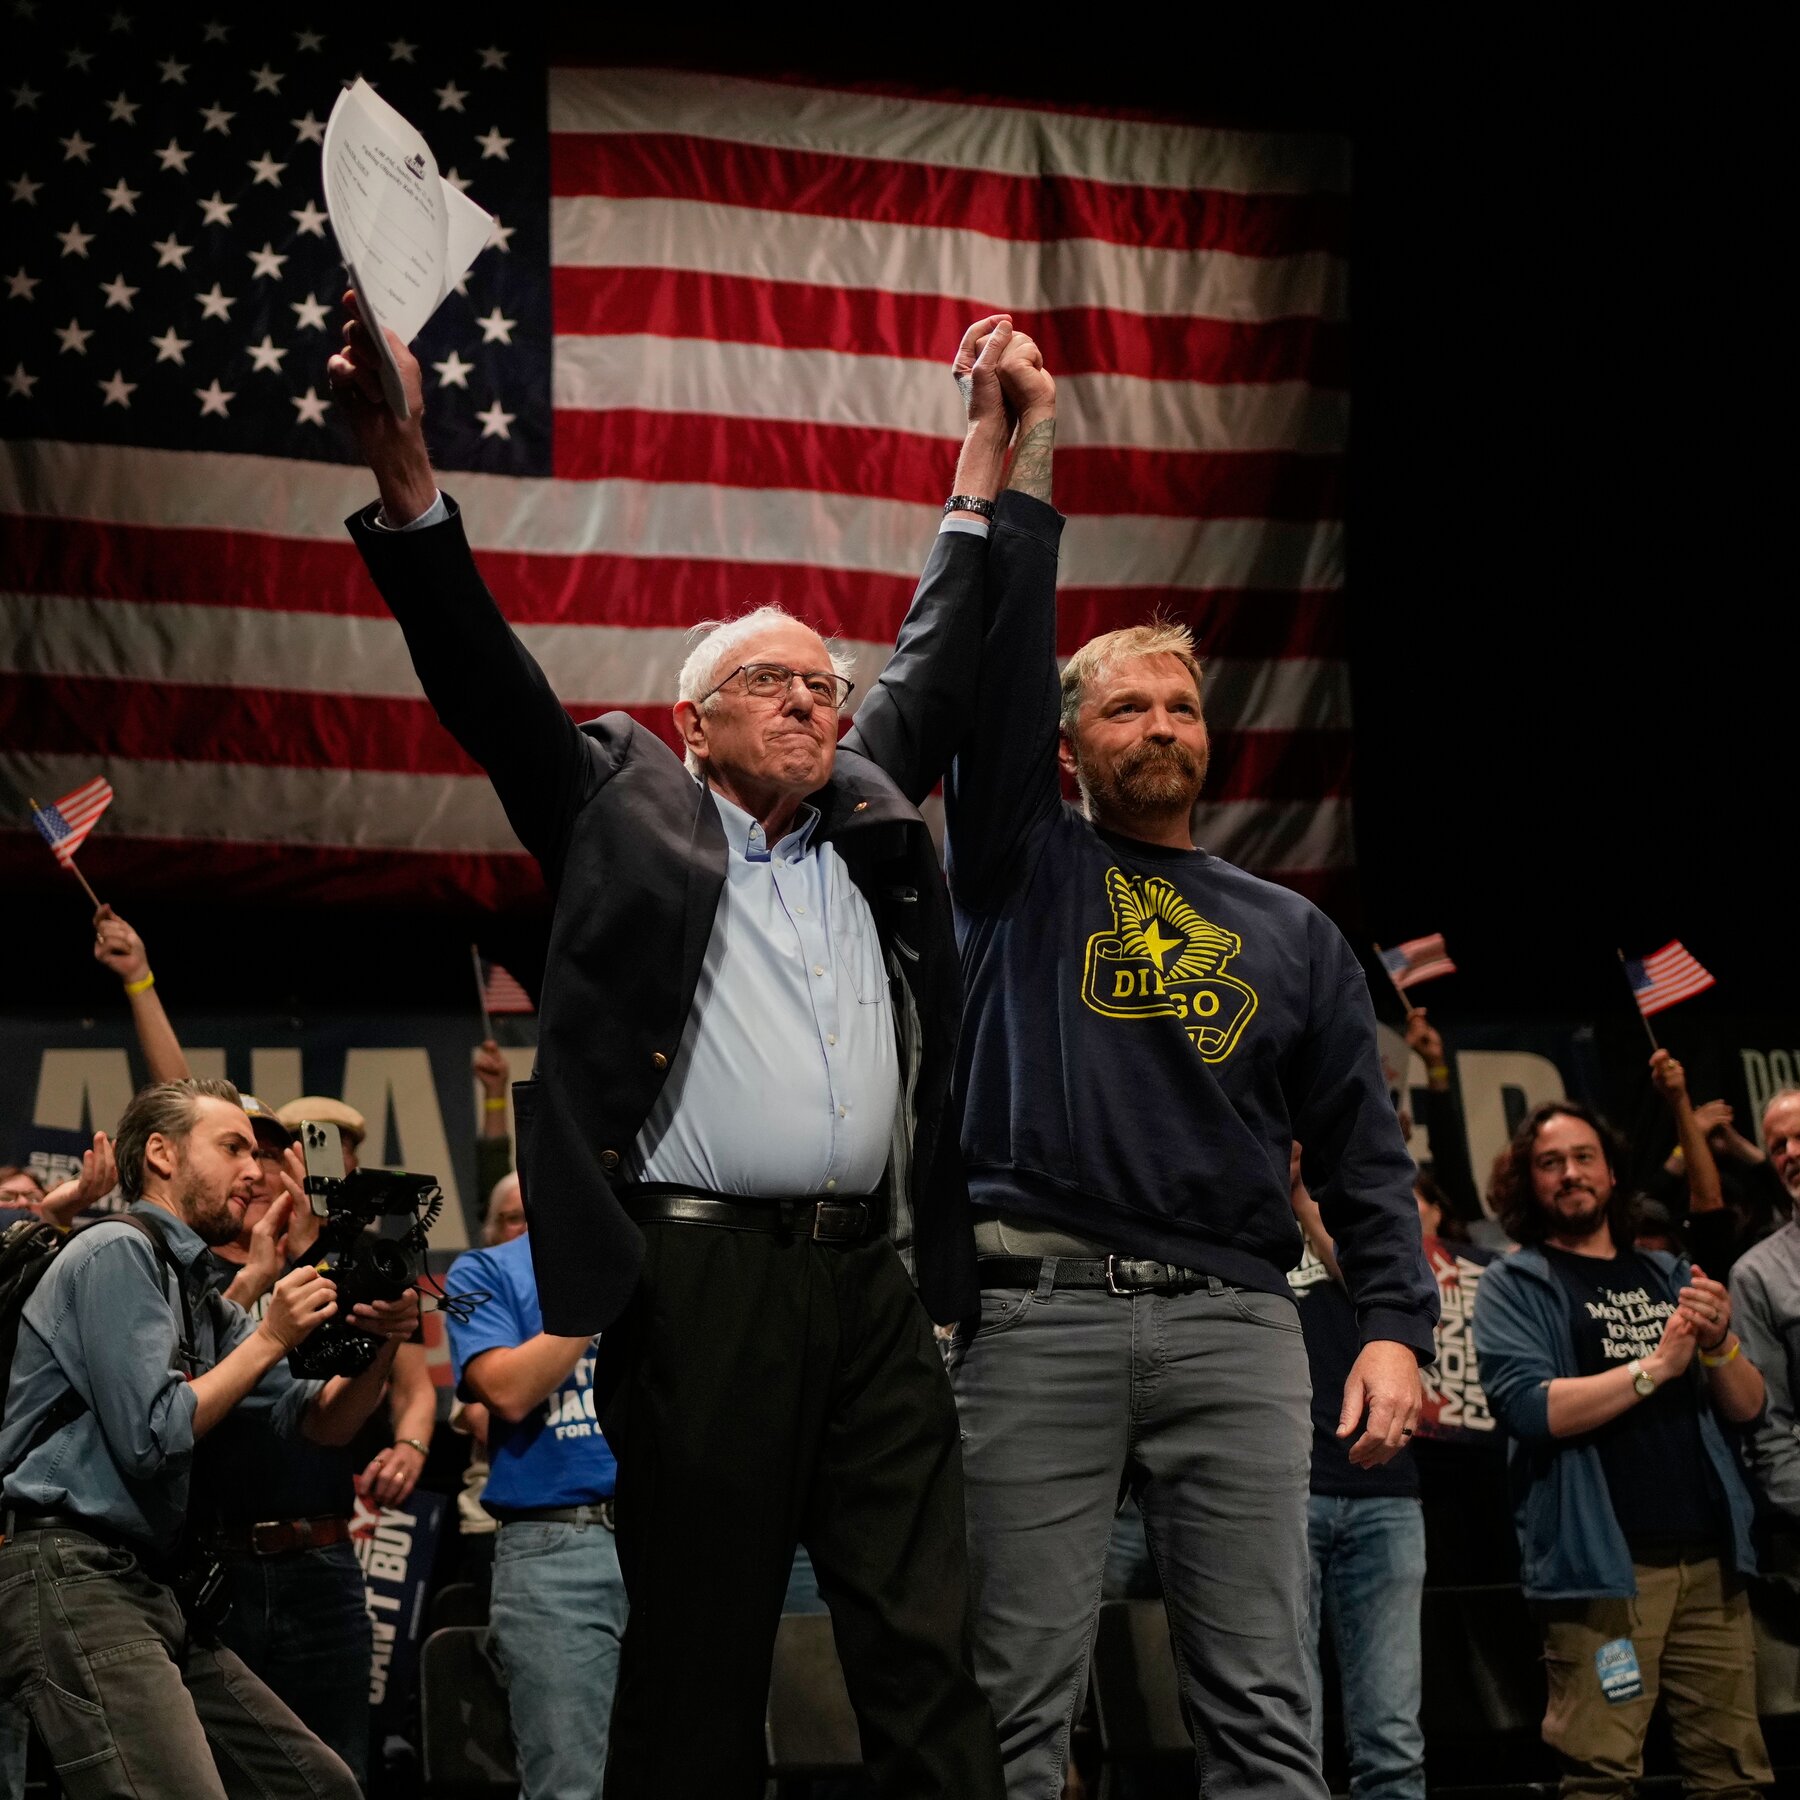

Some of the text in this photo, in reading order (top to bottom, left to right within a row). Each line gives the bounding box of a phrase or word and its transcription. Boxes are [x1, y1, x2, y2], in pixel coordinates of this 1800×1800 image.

[1432, 1252, 1466, 1427] MONEY
[555, 1422, 592, 1441] FOR
[369, 1506, 417, 1583] BUY
